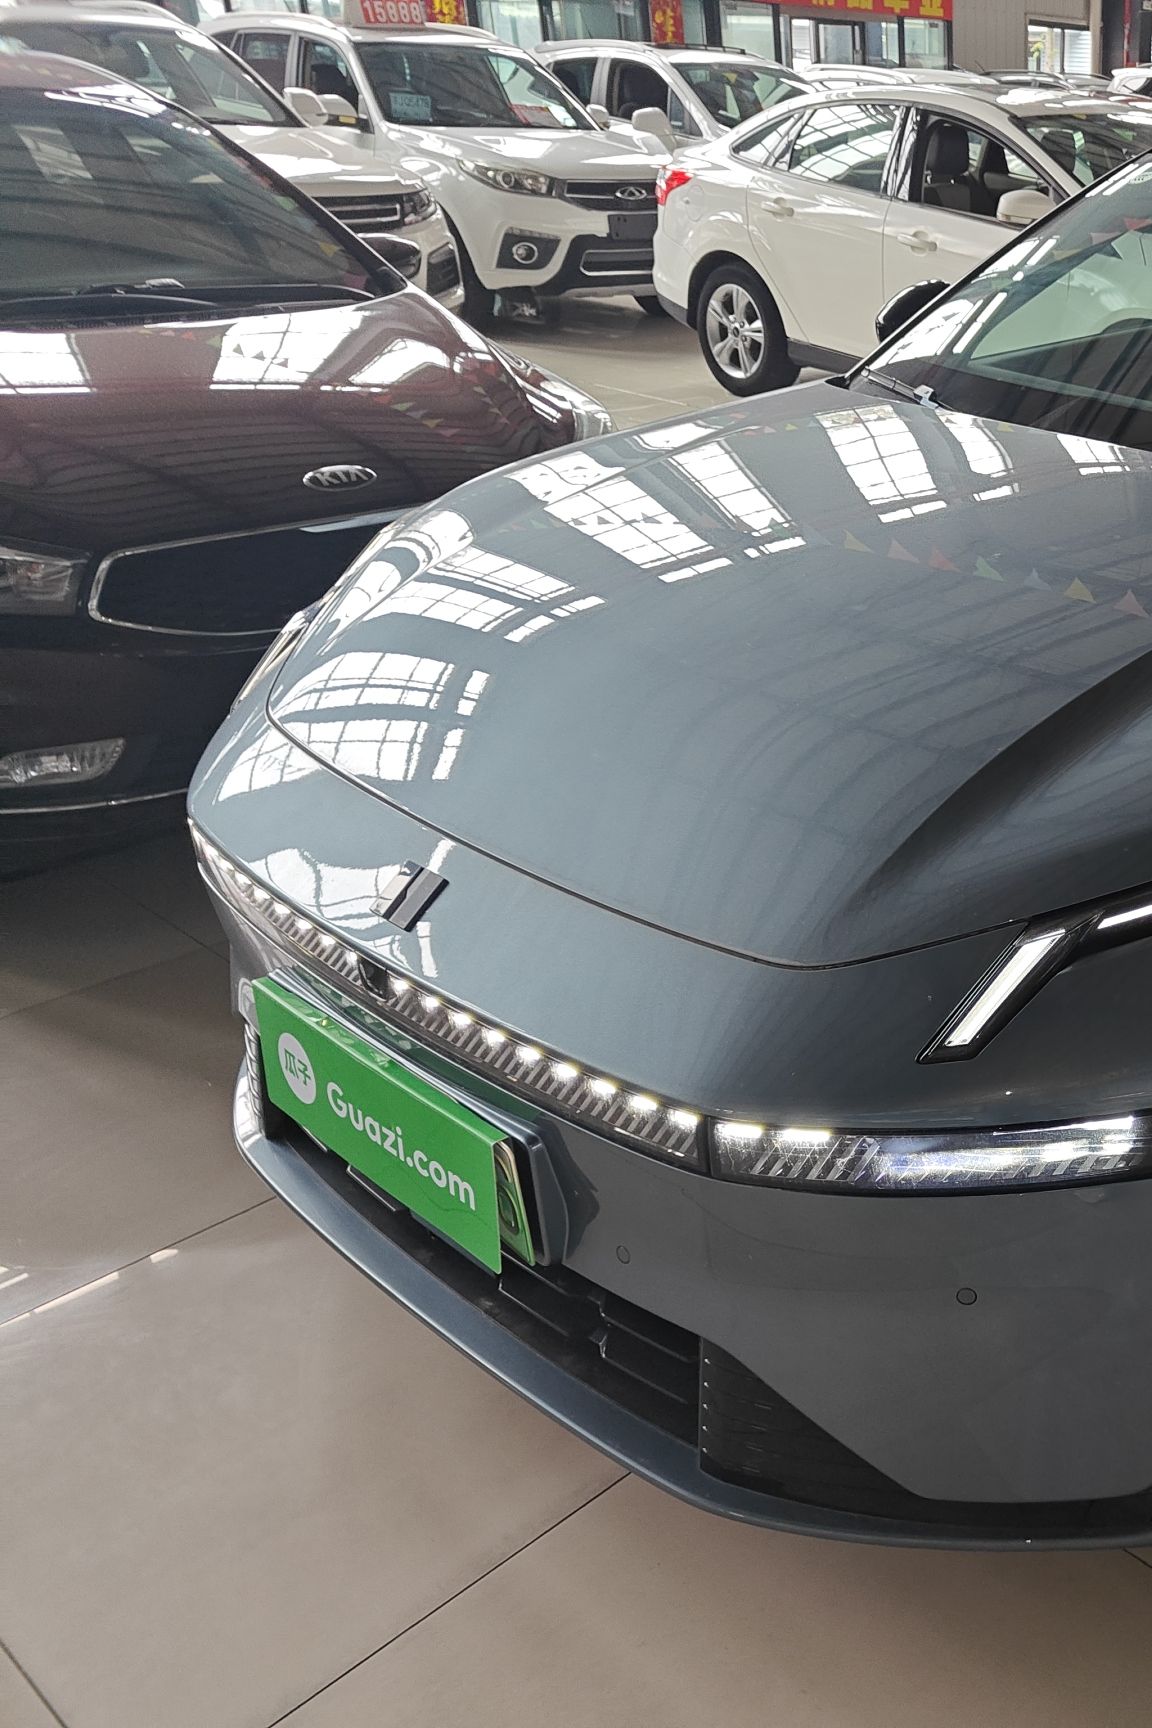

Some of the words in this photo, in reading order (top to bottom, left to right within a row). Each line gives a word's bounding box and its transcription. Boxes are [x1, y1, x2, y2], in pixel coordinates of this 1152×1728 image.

[362, 0, 422, 23] 15888
[313, 469, 371, 488] KIA
[284, 1048, 312, 1087] 瓜子
[326, 1081, 476, 1212] Guazi.com
